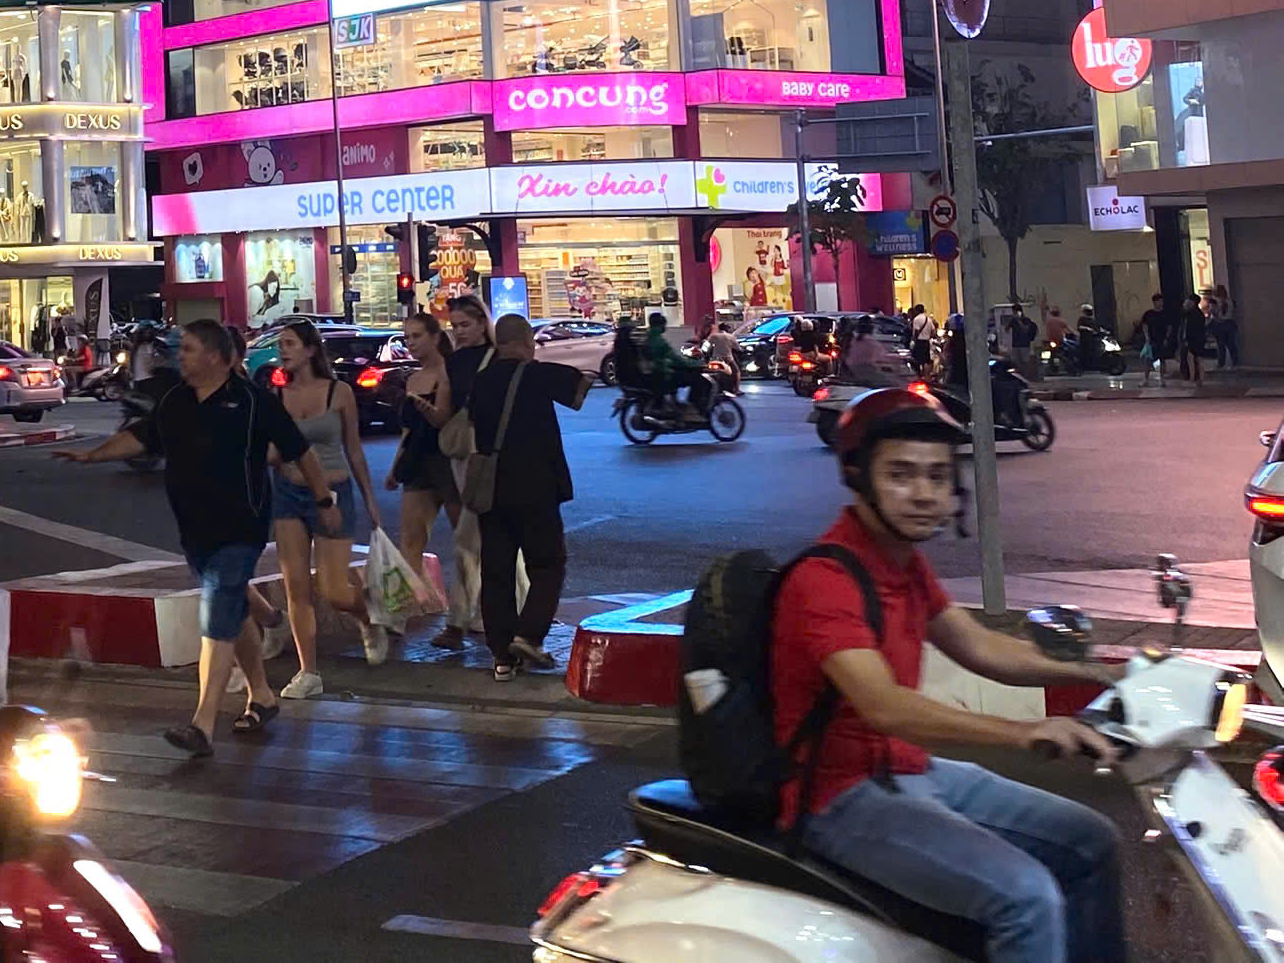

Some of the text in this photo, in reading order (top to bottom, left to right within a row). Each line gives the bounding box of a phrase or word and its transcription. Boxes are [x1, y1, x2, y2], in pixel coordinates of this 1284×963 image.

[338, 17, 372, 42] SJK
[508, 82, 669, 115] concung
[66, 113, 121, 130] DEXUS
[517, 173, 578, 199] Xin
[1094, 204, 1139, 216] ECHOLAC
[79, 247, 122, 260] DEXUS
